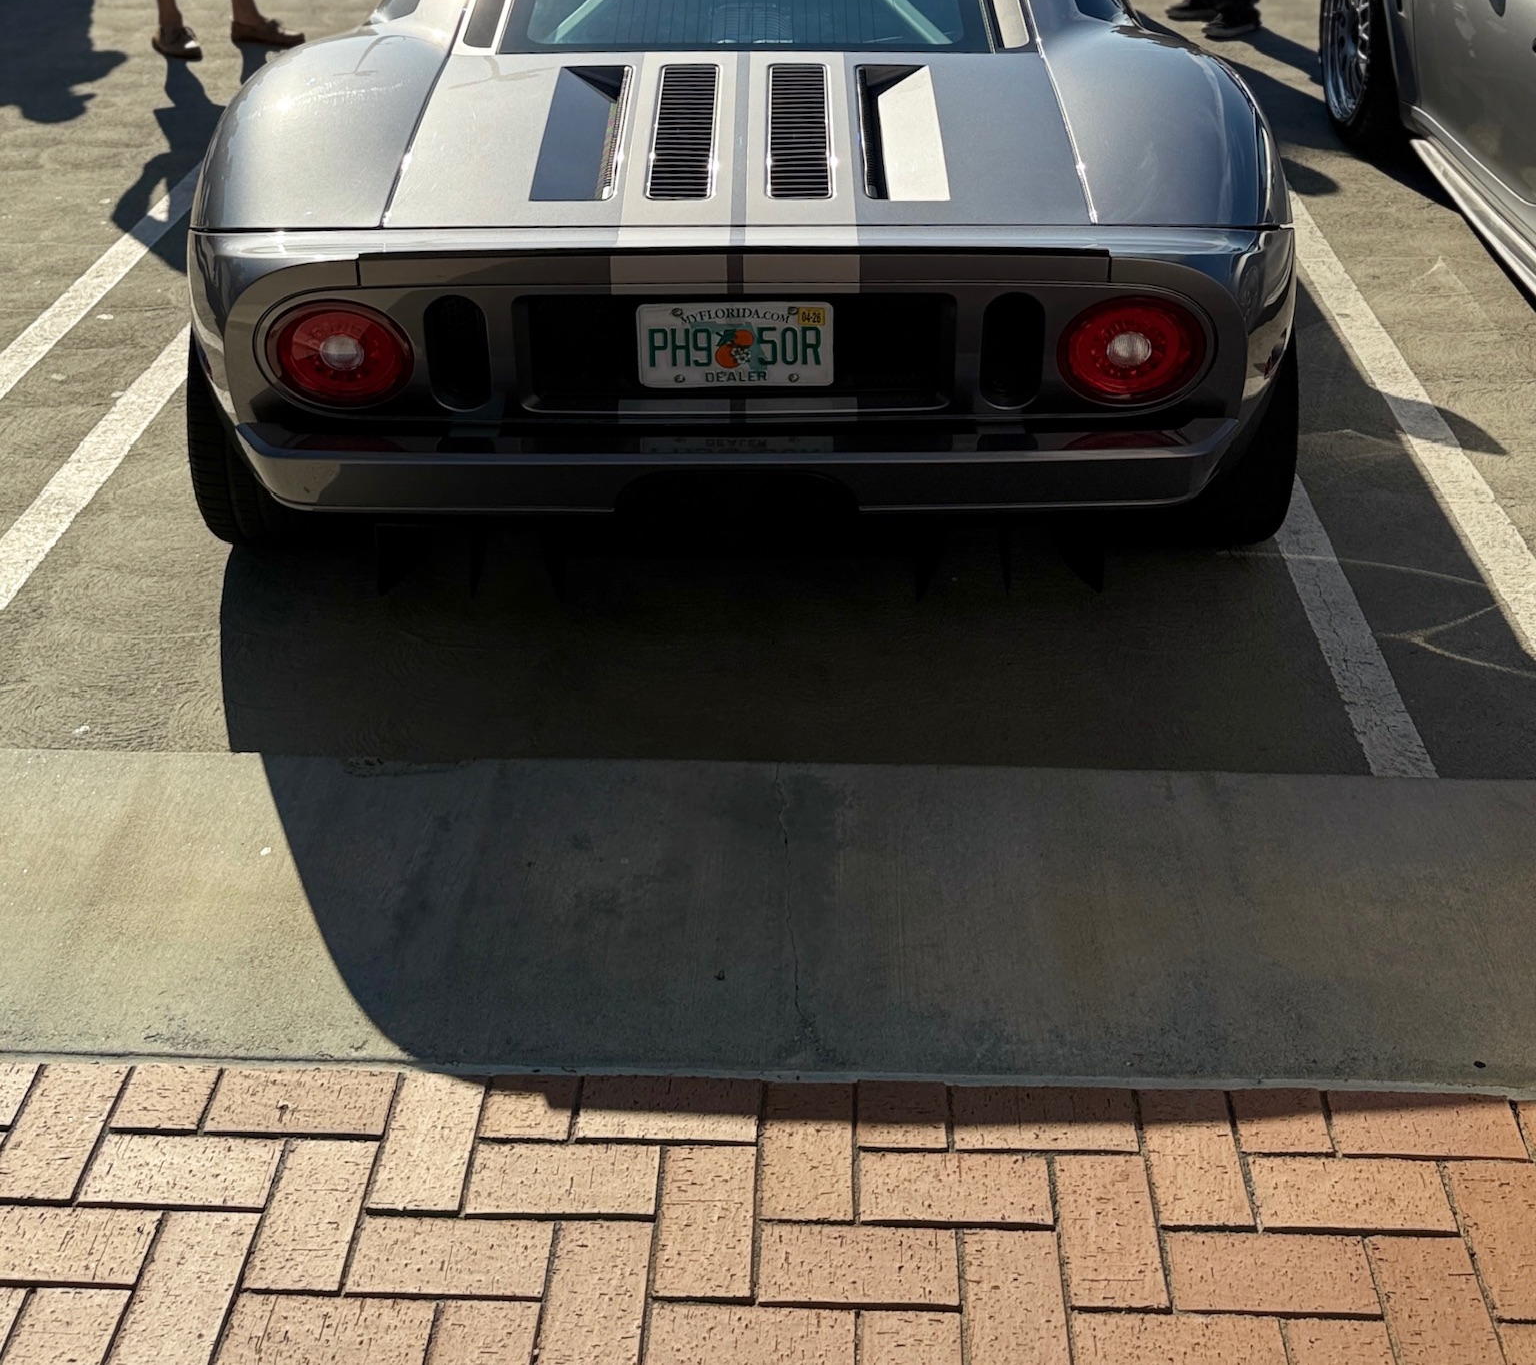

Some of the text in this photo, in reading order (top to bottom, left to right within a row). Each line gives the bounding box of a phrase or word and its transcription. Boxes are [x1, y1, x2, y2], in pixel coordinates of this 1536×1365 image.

[680, 308, 790, 325] MYFLORIDA.COM
[648, 327, 712, 367] PH9
[705, 371, 767, 382] DEALER
